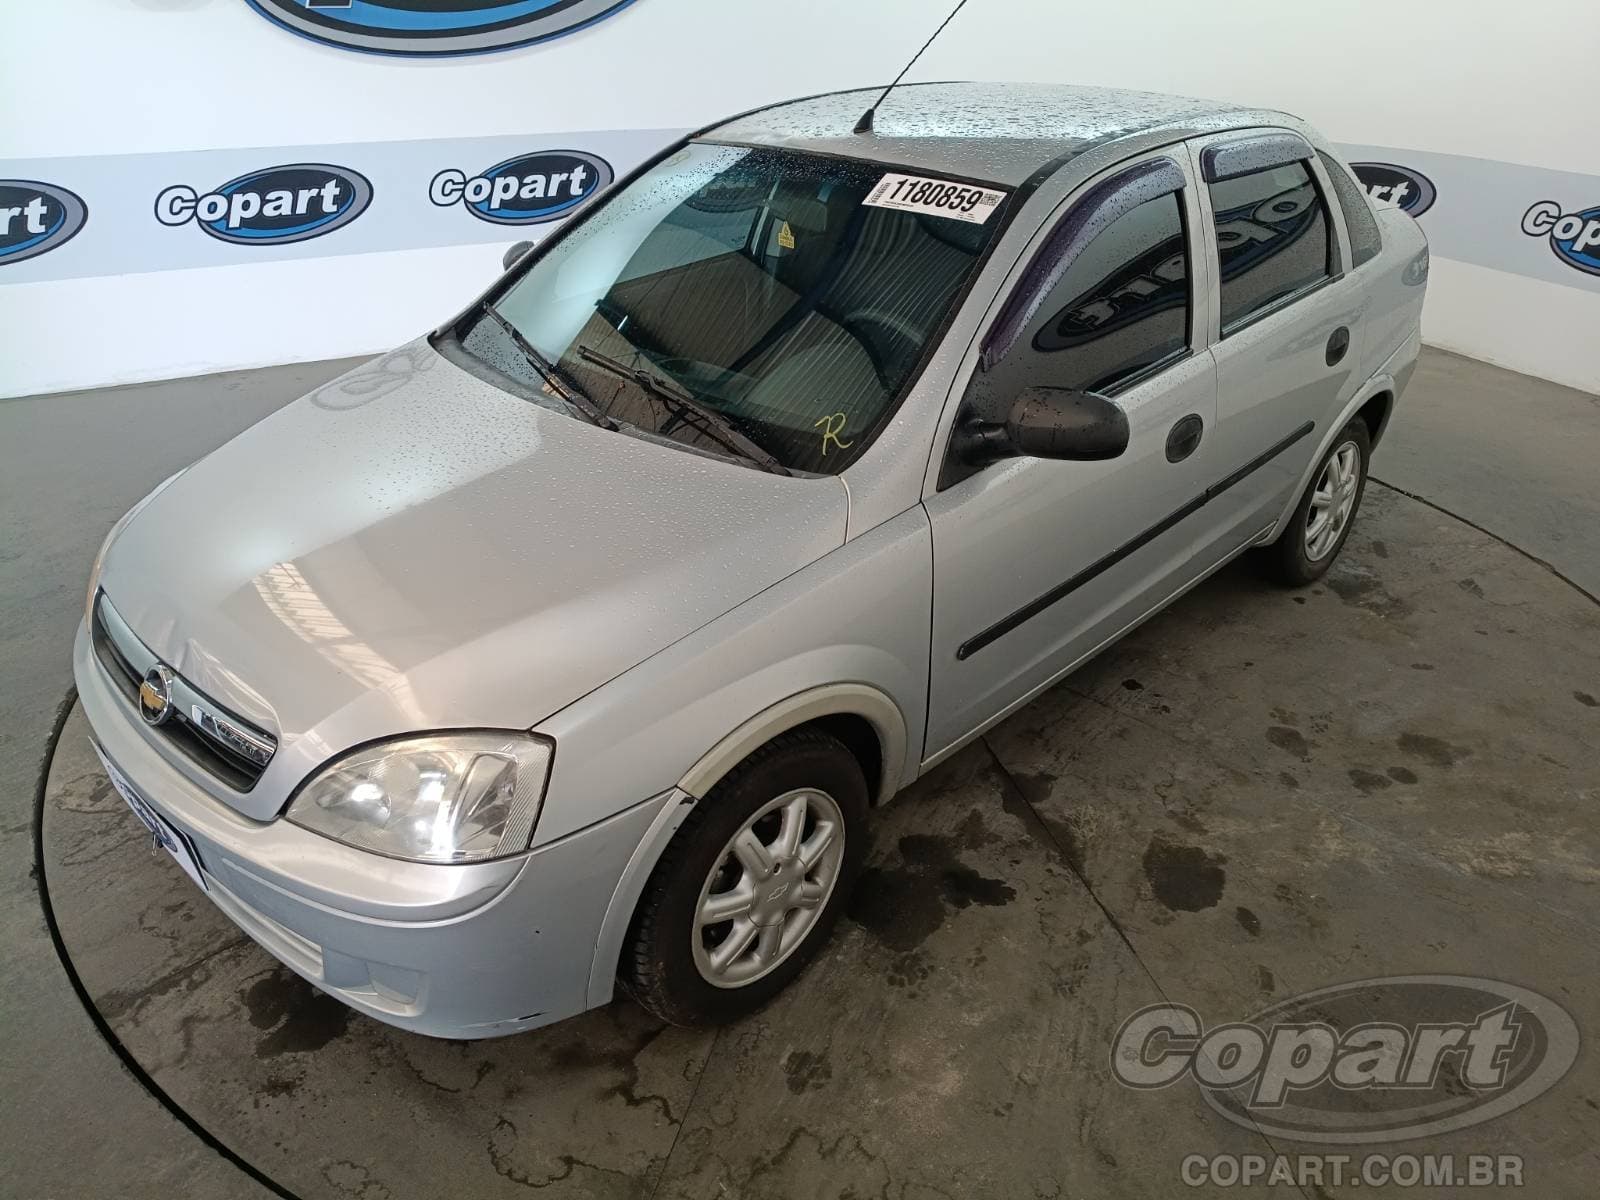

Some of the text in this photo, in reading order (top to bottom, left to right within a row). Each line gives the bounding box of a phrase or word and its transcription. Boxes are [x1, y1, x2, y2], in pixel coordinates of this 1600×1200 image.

[154, 178, 342, 230] Copart
[429, 167, 587, 210] Copart
[889, 178, 984, 213] 1180859
